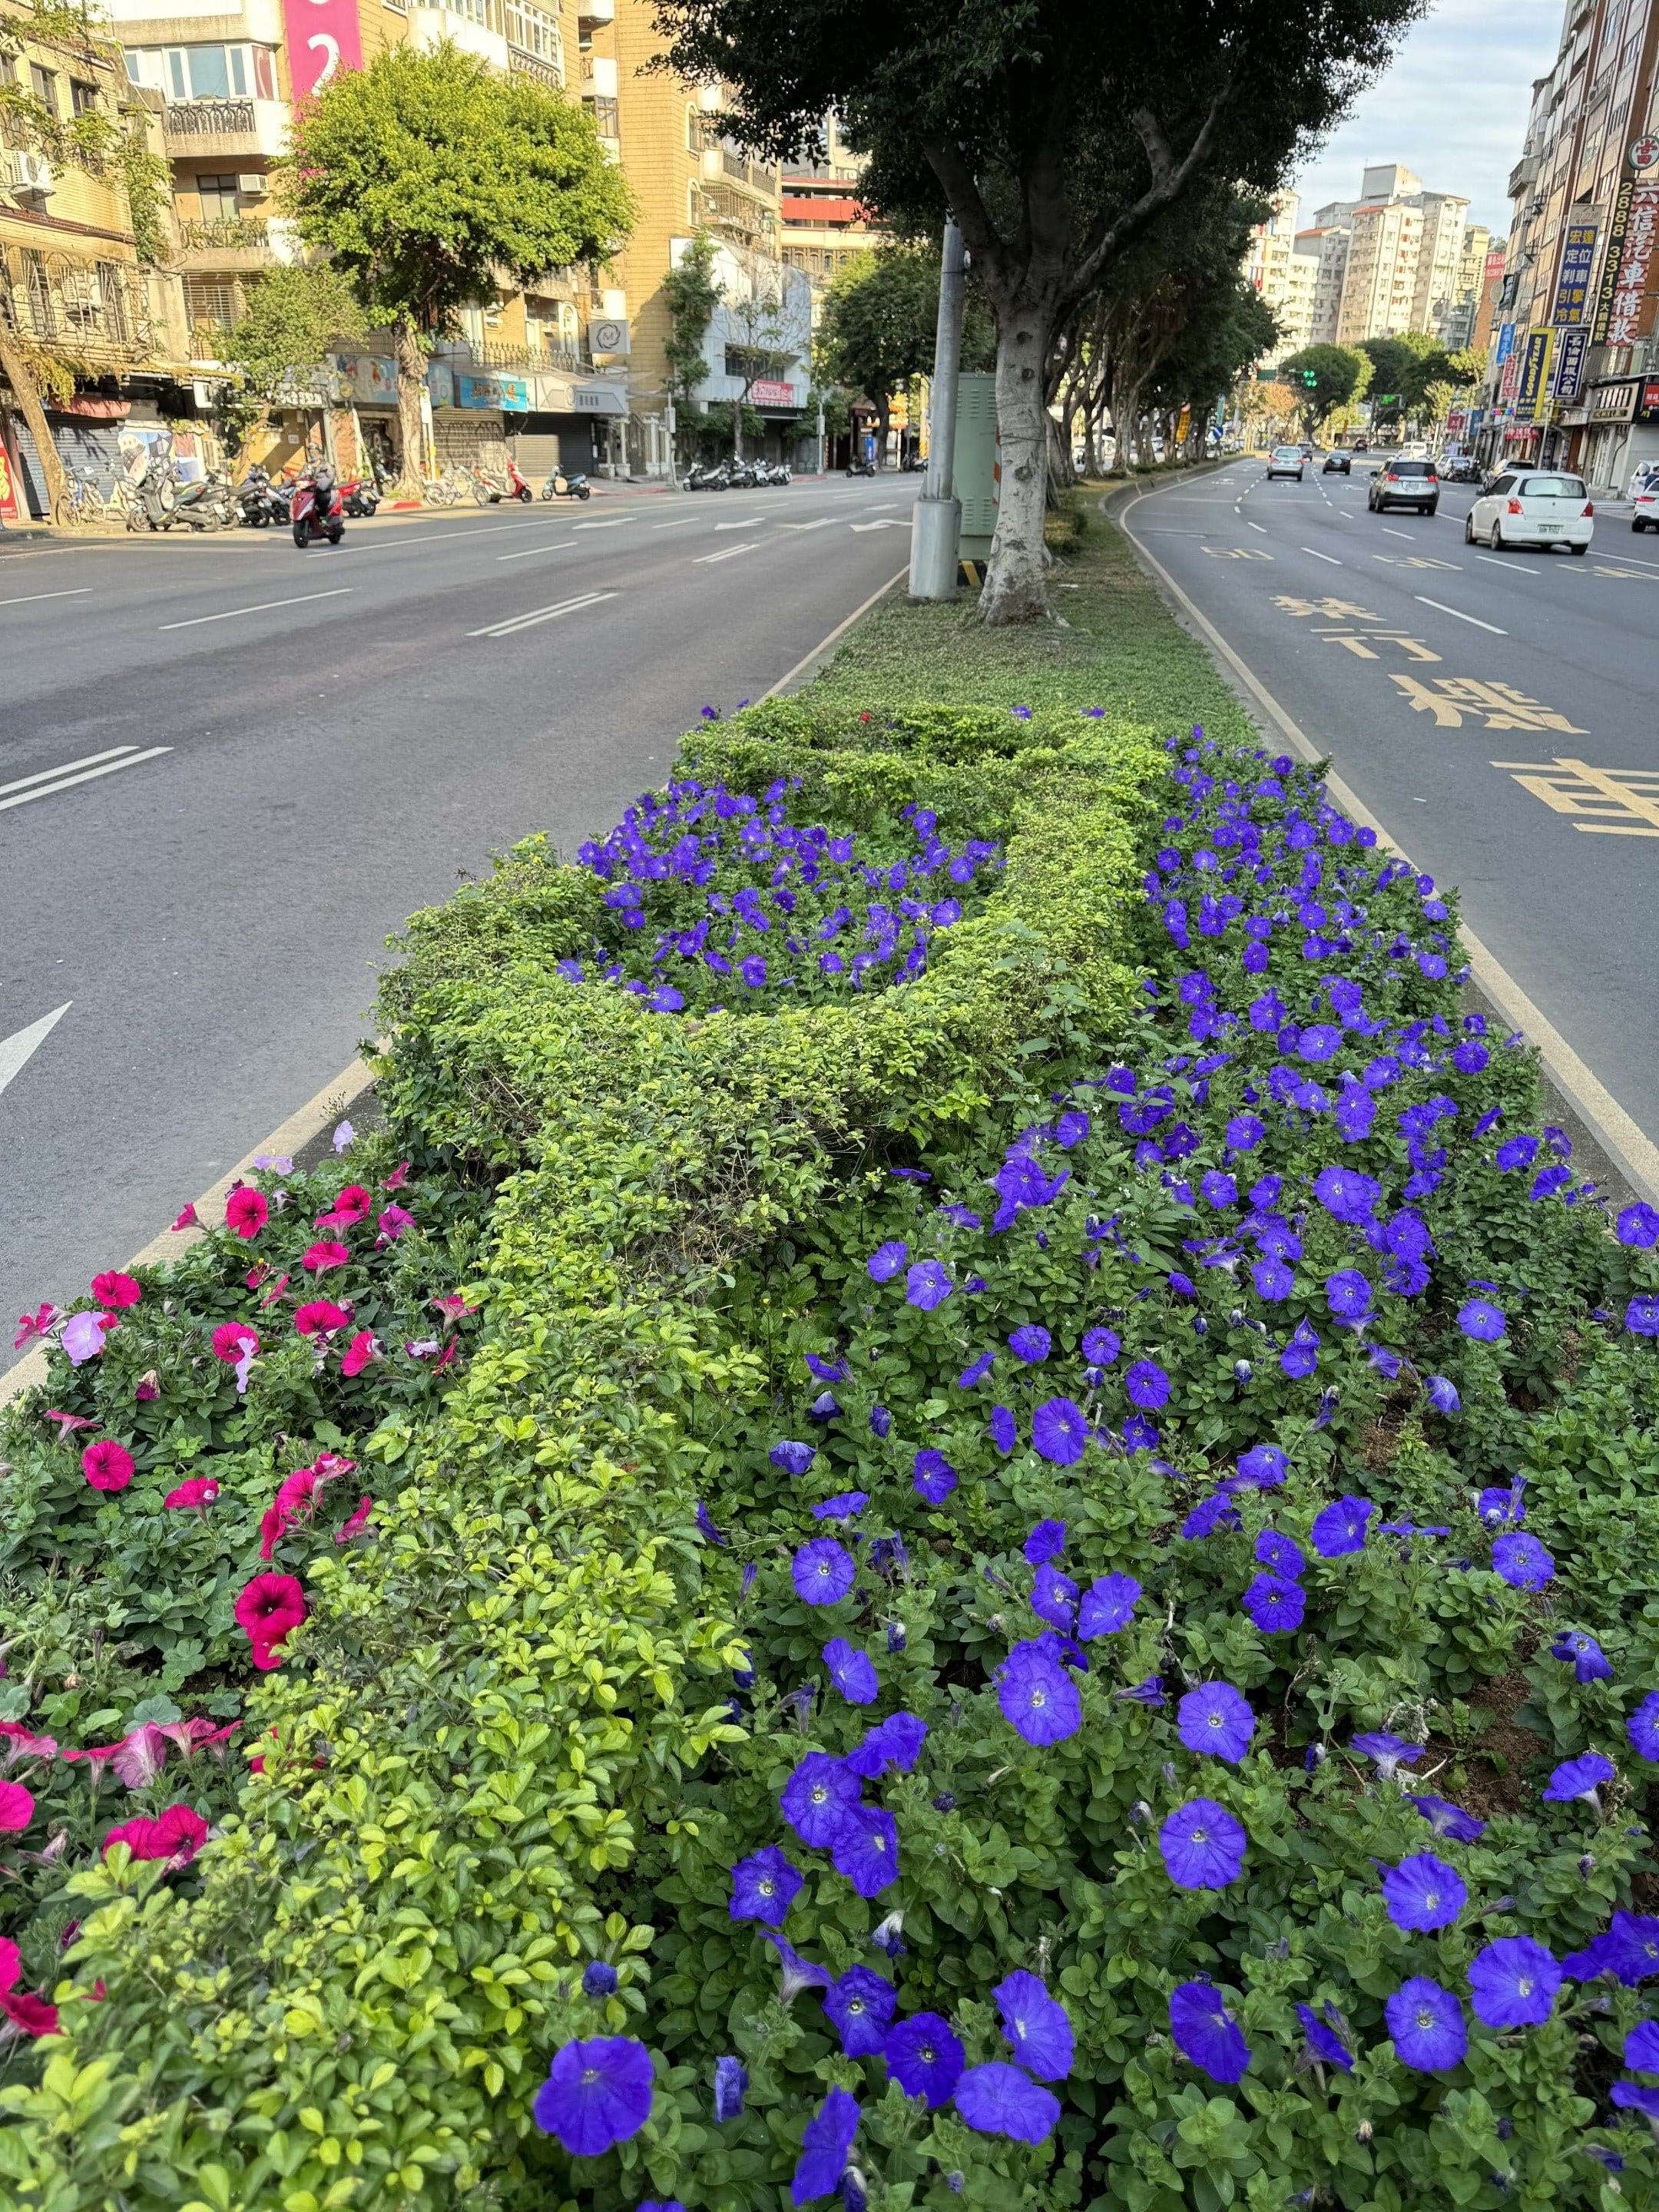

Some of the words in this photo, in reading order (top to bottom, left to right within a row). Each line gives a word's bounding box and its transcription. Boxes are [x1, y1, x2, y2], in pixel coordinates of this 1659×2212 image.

[1636, 139, 1657, 164] 當
[1569, 230, 1595, 244] 宏達
[1566, 249, 1592, 263] 定位
[1607, 180, 1659, 343] 六信汽車借款
[1558, 289, 1584, 303] 引擎
[1555, 308, 1581, 323] 冷氣
